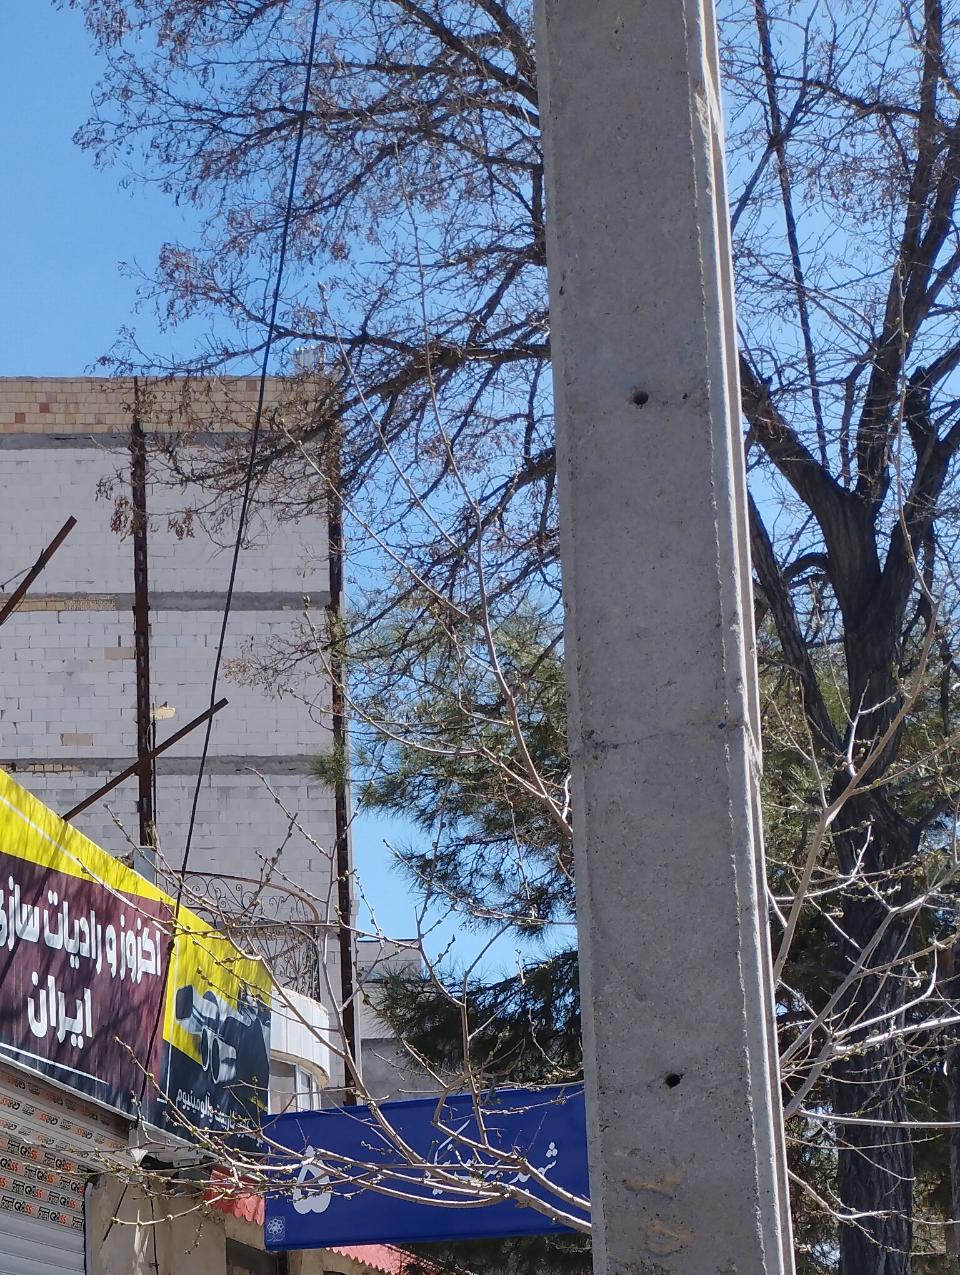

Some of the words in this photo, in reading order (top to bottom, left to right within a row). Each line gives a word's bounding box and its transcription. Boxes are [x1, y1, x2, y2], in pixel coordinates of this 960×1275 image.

[43, 890, 103, 975] رادیات
[105, 924, 117, 979] و
[27, 971, 93, 1050] ایران
